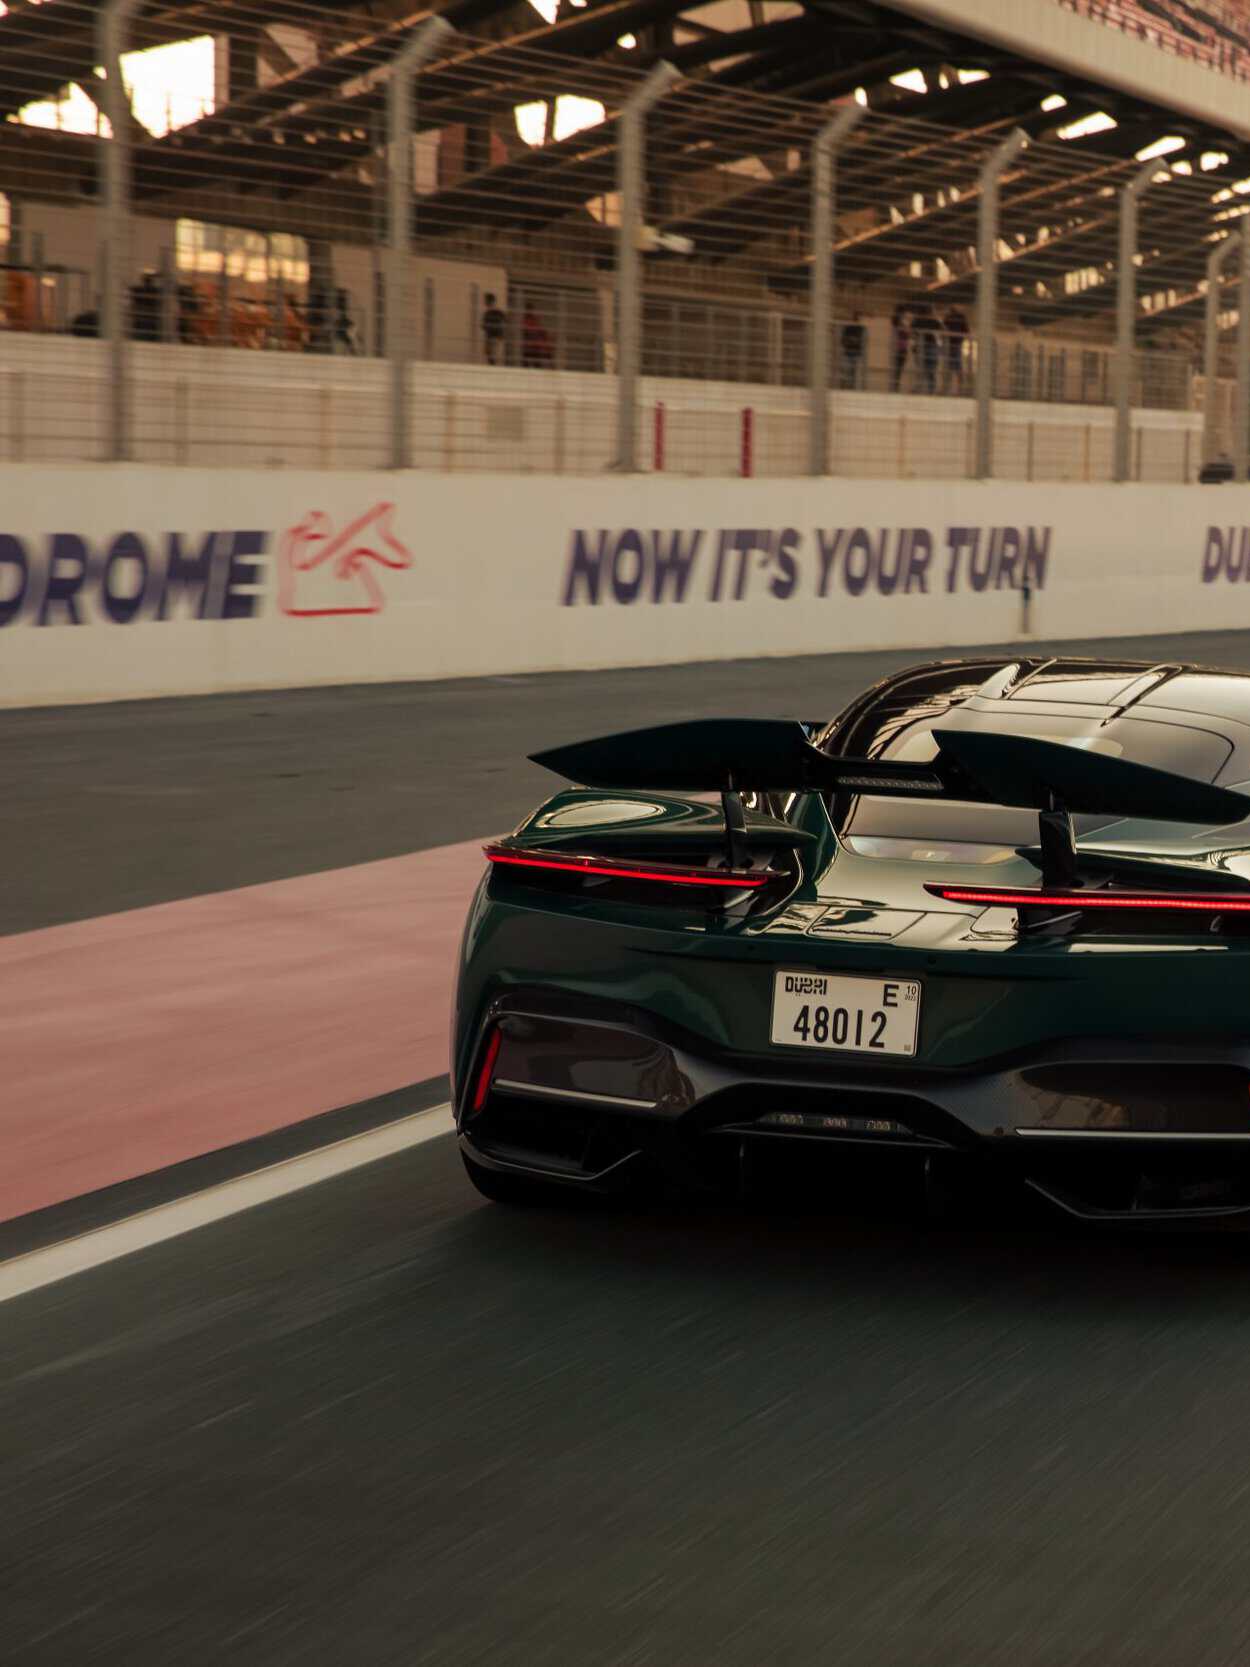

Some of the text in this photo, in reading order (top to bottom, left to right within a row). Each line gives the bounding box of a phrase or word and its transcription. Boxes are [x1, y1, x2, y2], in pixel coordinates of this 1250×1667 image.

[560, 526, 1054, 606] NOW IT'S YOUR TURN
[785, 975, 828, 996] DUBAI
[883, 984, 900, 1007] E
[907, 985, 917, 995] 10
[793, 1005, 888, 1049] 48012
